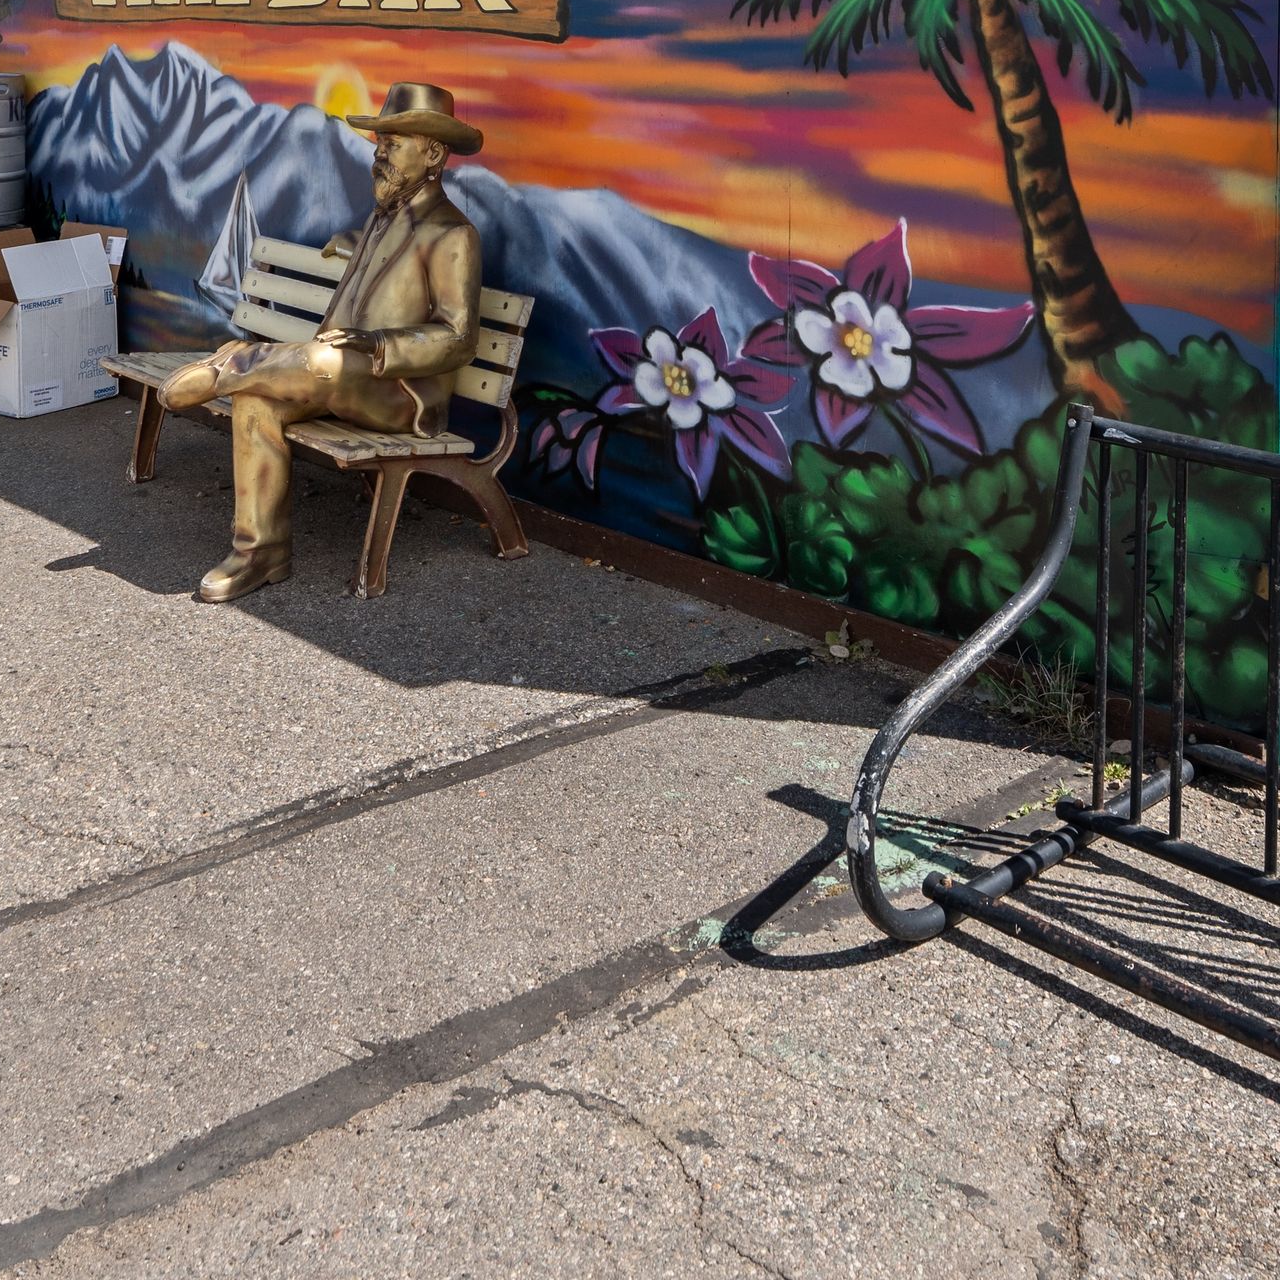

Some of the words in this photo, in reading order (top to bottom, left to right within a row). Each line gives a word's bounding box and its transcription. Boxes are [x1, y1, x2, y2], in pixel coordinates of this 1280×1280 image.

[20, 297, 63, 310] THERMOSAFE
[88, 344, 112, 357] every
[78, 367, 106, 380] matte
